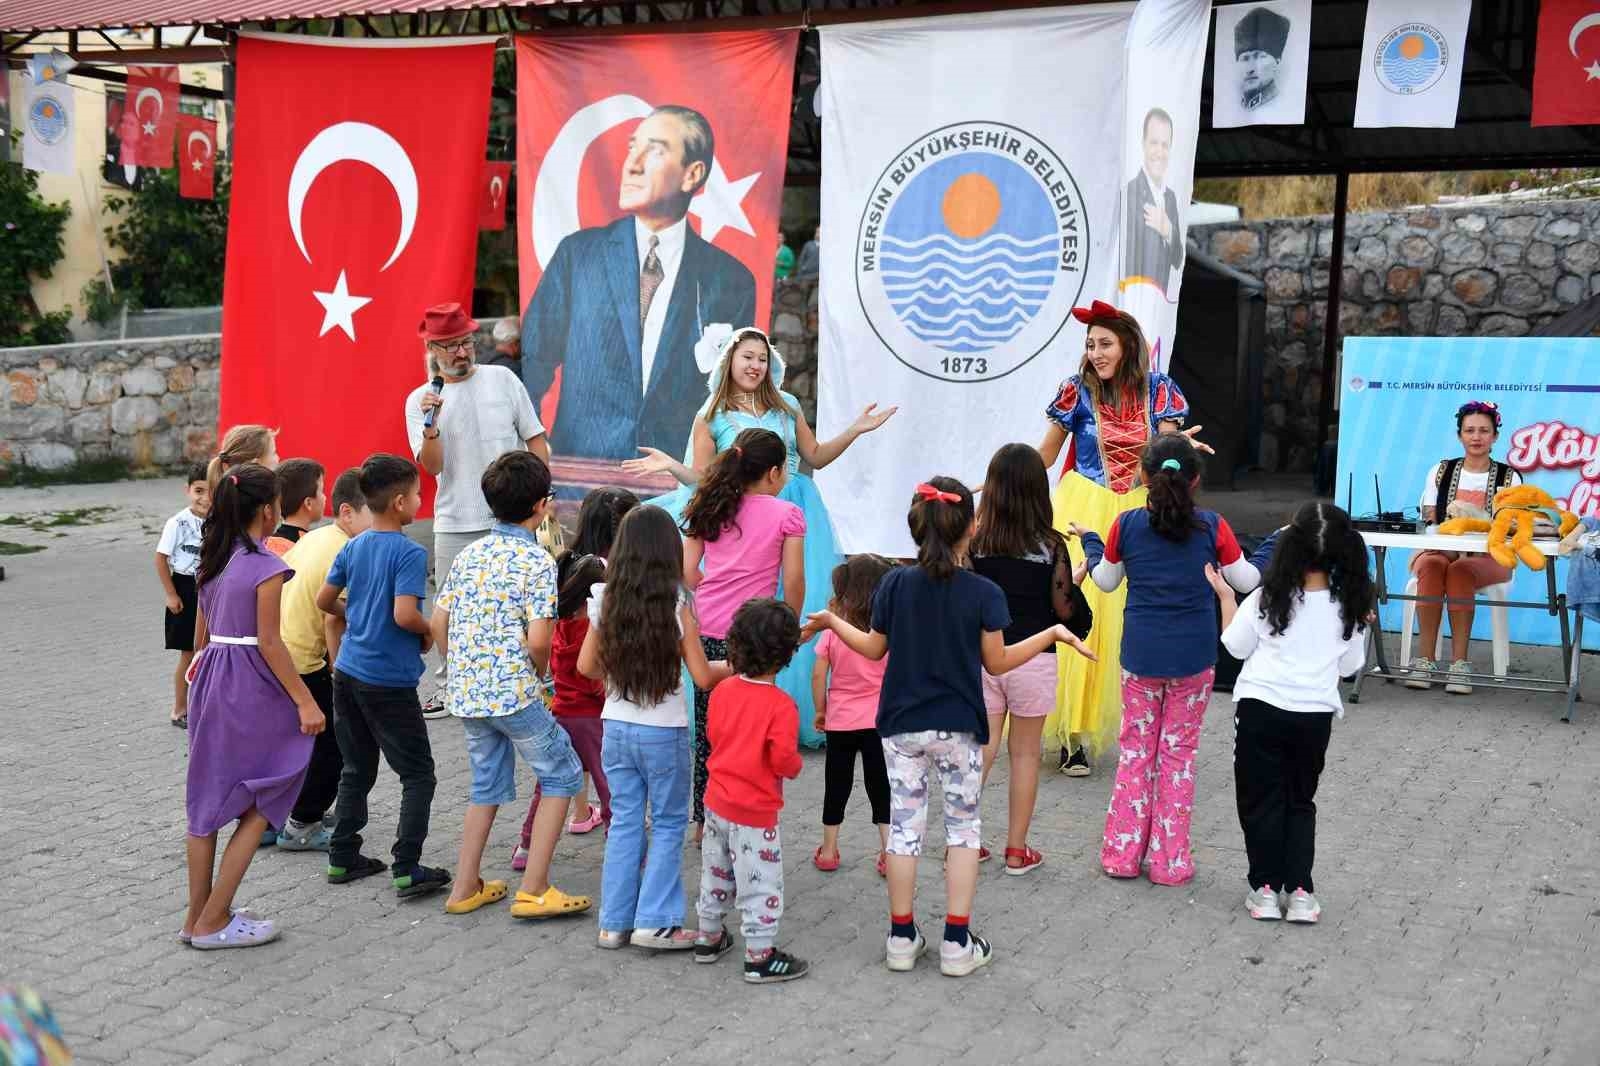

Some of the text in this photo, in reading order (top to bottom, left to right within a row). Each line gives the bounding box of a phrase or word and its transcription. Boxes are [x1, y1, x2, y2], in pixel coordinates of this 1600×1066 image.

[863, 130, 1079, 273] MERSİN BÜYÜKŞEHİR BELEDİYESİ
[940, 357, 988, 375] 1873
[1402, 380, 1435, 391] MERSİN
